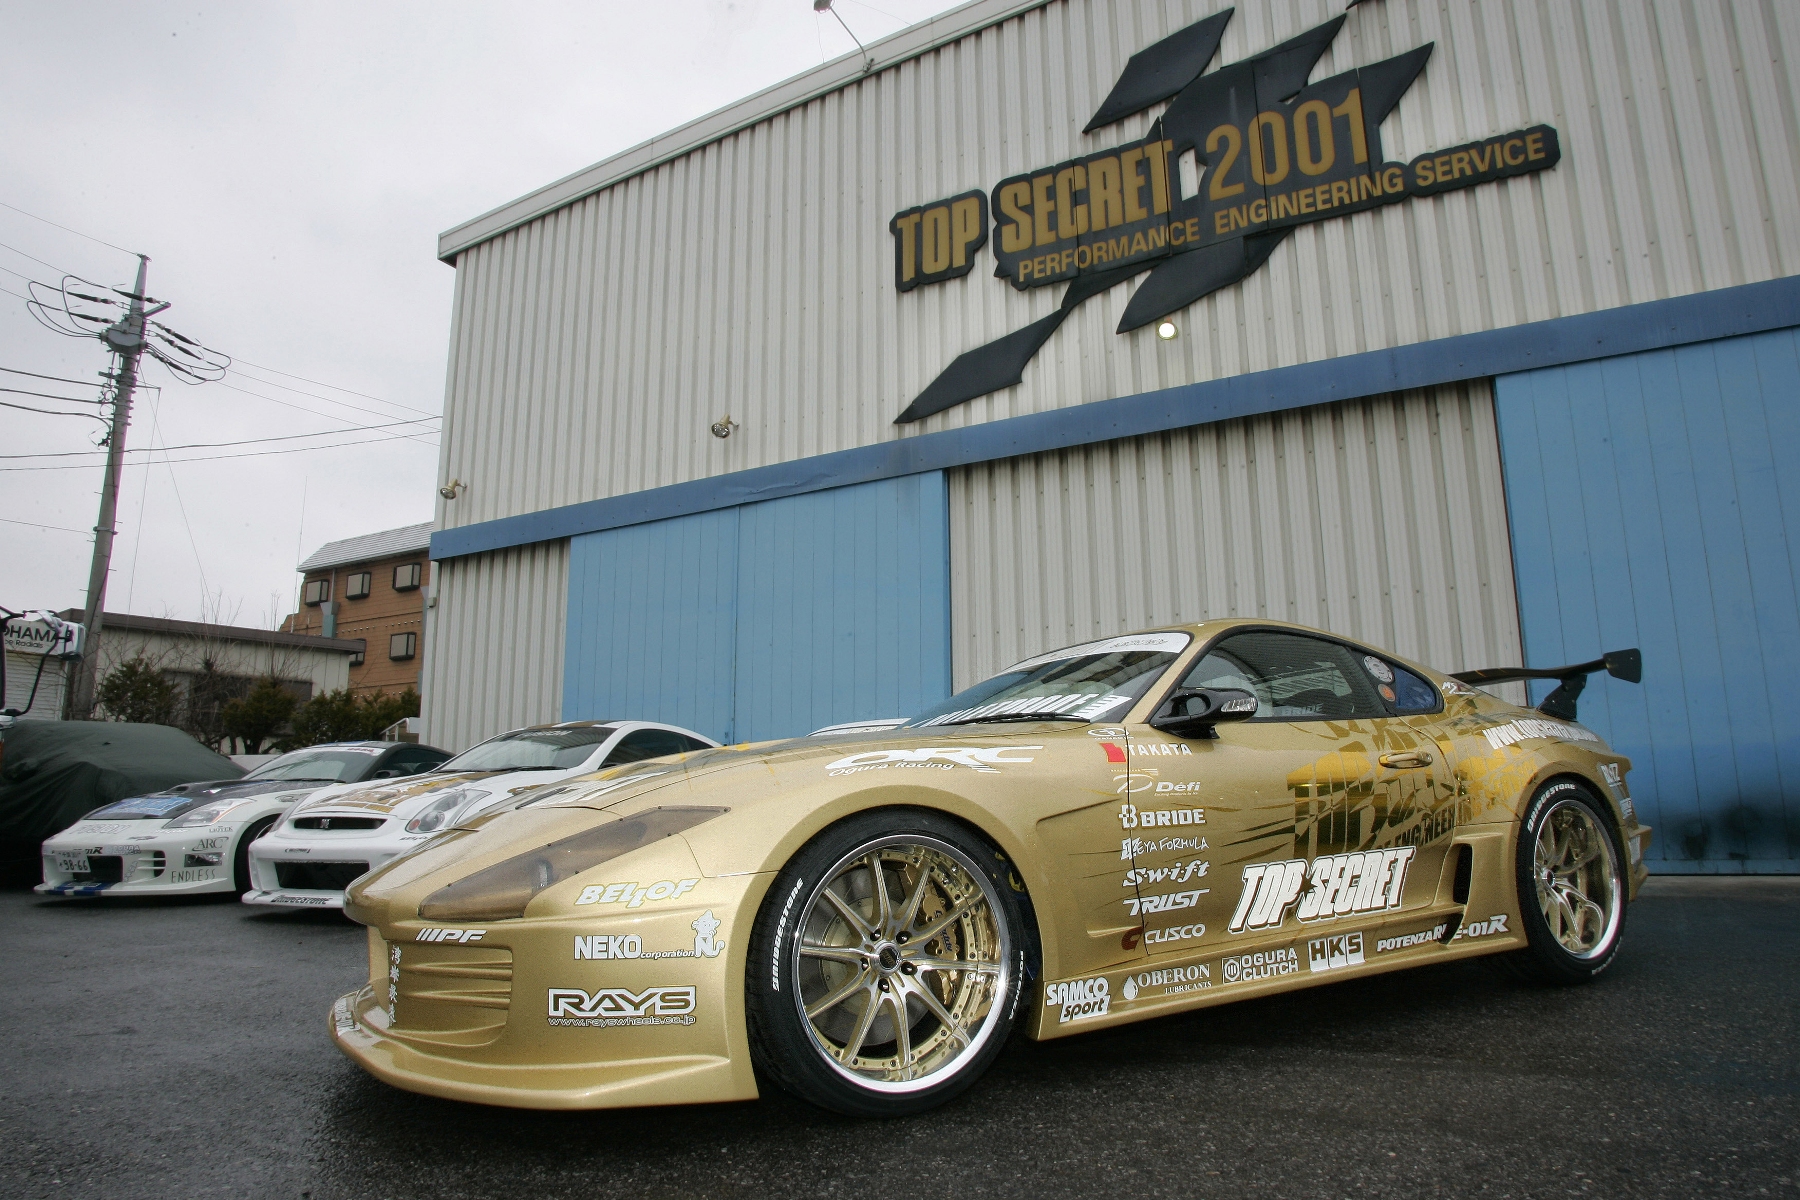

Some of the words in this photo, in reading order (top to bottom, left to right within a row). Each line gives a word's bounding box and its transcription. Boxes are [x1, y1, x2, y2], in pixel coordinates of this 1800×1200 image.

[897, 196, 980, 282] TOP
[999, 139, 1173, 254] SECRET
[1205, 88, 1369, 201] 2001
[1018, 217, 1200, 282] PERFORMANCE
[1214, 166, 1405, 235] ENGINEERING
[1415, 132, 1546, 187] SERVICE
[825, 745, 1043, 773] ORC
[1125, 743, 1193, 756] TAKATA
[828, 761, 890, 776] Ogura
[894, 761, 955, 770] Racing
[1140, 808, 1207, 828] BRIDE
[194, 837, 227, 851] ARC
[1158, 836, 1209, 851] FORMULA
[171, 869, 216, 883] ENDLESS
[574, 878, 700, 908] BELLOF
[1229, 859, 1310, 933] TOP
[1296, 846, 1416, 922] SECRET
[1122, 888, 1210, 915] TRUST
[1145, 923, 1206, 944] CUSCO
[1376, 931, 1433, 952] POTENZA
[574, 934, 642, 960] NEKO
[641, 949, 695, 960] corporation
[1241, 947, 1298, 968] OGURA
[1309, 931, 1365, 971] HKS
[1137, 963, 1211, 987] OBERON
[1242, 960, 1299, 981] CLUTCH
[1046, 976, 1109, 1006] SAMCO
[1165, 980, 1212, 995] LUBRICANTS
[548, 986, 697, 1017] RAYS
[1063, 997, 1106, 1021] sport
[548, 1015, 697, 1028] www.rayswheels.co.jp
